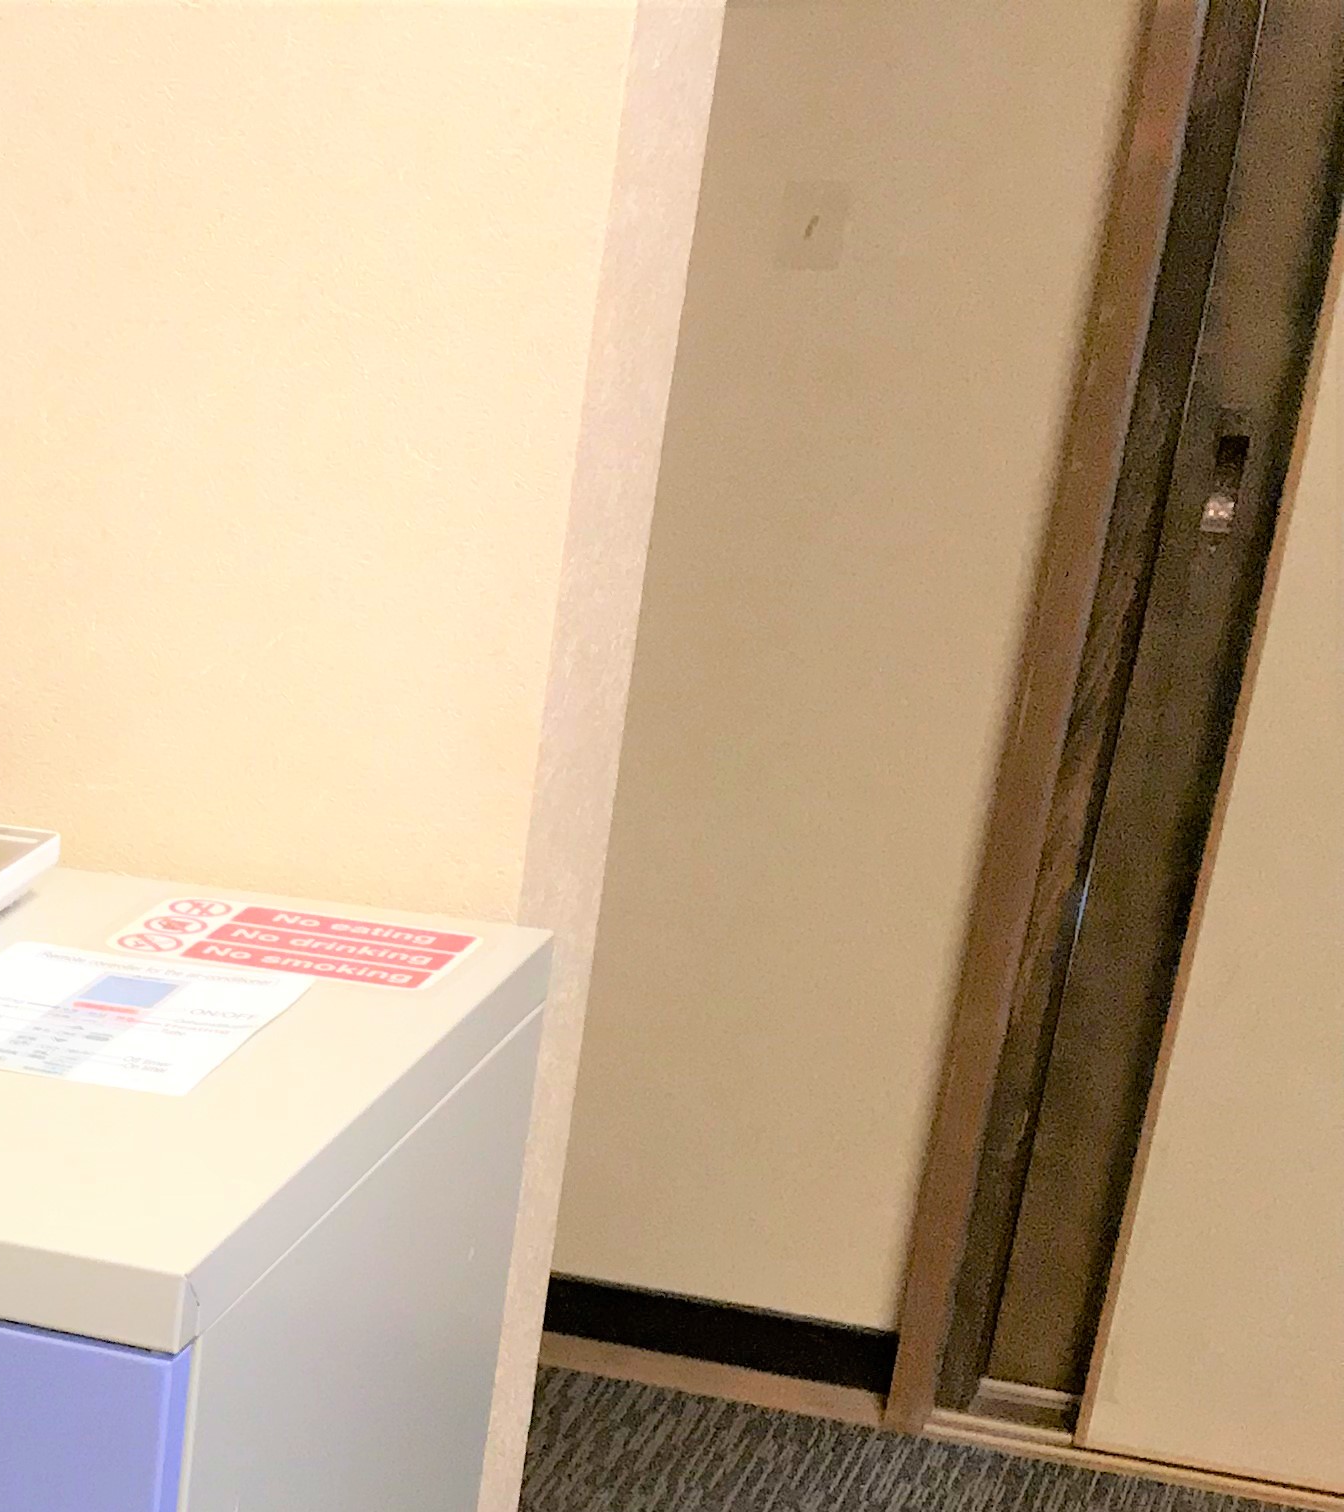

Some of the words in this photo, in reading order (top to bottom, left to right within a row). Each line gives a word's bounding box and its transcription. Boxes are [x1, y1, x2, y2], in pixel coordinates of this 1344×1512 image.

[230, 927, 279, 943] No
[288, 935, 434, 967] drinking
[273, 912, 321, 928] No
[330, 918, 438, 946] eating
[202, 944, 252, 961] No
[260, 952, 414, 985] smoking
